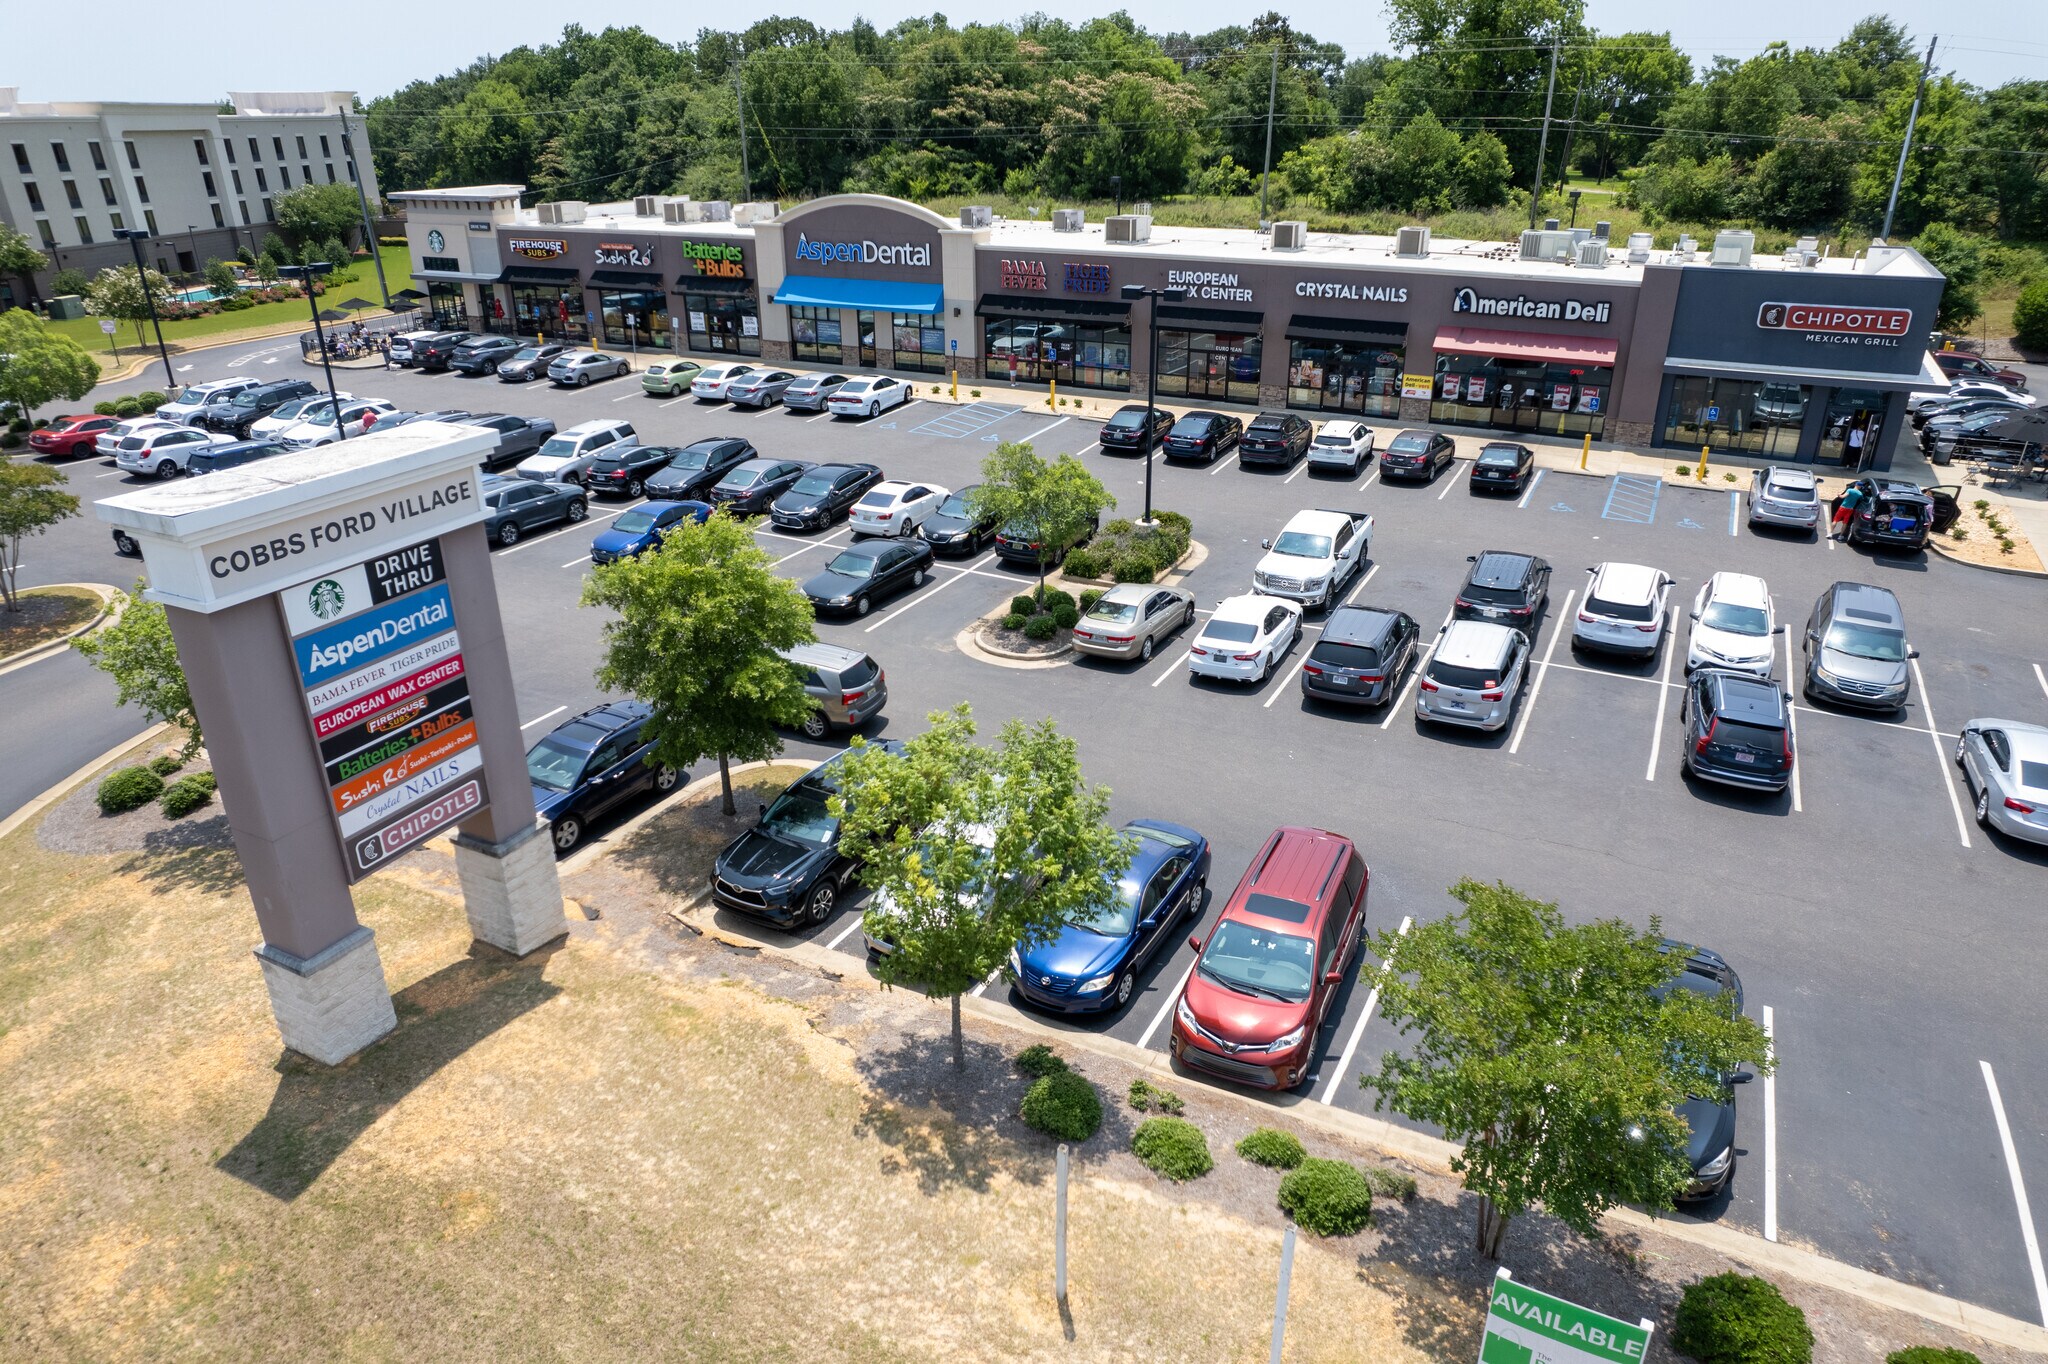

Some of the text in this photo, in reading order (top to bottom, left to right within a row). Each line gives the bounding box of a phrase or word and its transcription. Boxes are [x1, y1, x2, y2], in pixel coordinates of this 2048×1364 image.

[510, 240, 563, 254] FIREHOUSE
[527, 248, 547, 257] SUBS
[595, 249, 627, 266] Sushi
[682, 240, 743, 261] Batteries
[795, 232, 931, 266] AspenDental
[706, 259, 744, 278] Bulbs
[1001, 259, 1047, 276] BAMA
[1063, 262, 1110, 279] TIGER
[1000, 274, 1047, 290] FEVER
[1063, 278, 1110, 294] PRIDE
[1168, 270, 1238, 287] EUROPEAN
[1201, 286, 1253, 302] CENTER
[1295, 281, 1408, 303] CRYSTAL NAILS
[1453, 288, 1610, 322] American Deli
[1792, 311, 1904, 330] CHIPOTLE
[1805, 334, 1899, 347] MEXICAN GRILL
[210, 480, 472, 579] COBBS FORD VILLAGE
[374, 543, 432, 579] DRIVE
[381, 564, 434, 597] THRU
[309, 598, 448, 674] AspenDental
[312, 636, 457, 707] BAMA FEVER TIGER PRIDE
[318, 660, 461, 733] EUROPEAN WAX CENTER
[368, 698, 427, 734] FIREHOUSE
[388, 714, 410, 728] SUBS
[338, 736, 409, 780] Batteries
[421, 710, 464, 740] Bulbs
[340, 780, 381, 809] Sushi
[366, 759, 460, 820] Crystal NAILS
[387, 788, 475, 846] CHIPOTLE
[1493, 1292, 1644, 1358] AVAILABLE
[1537, 1352, 1552, 1362] The
